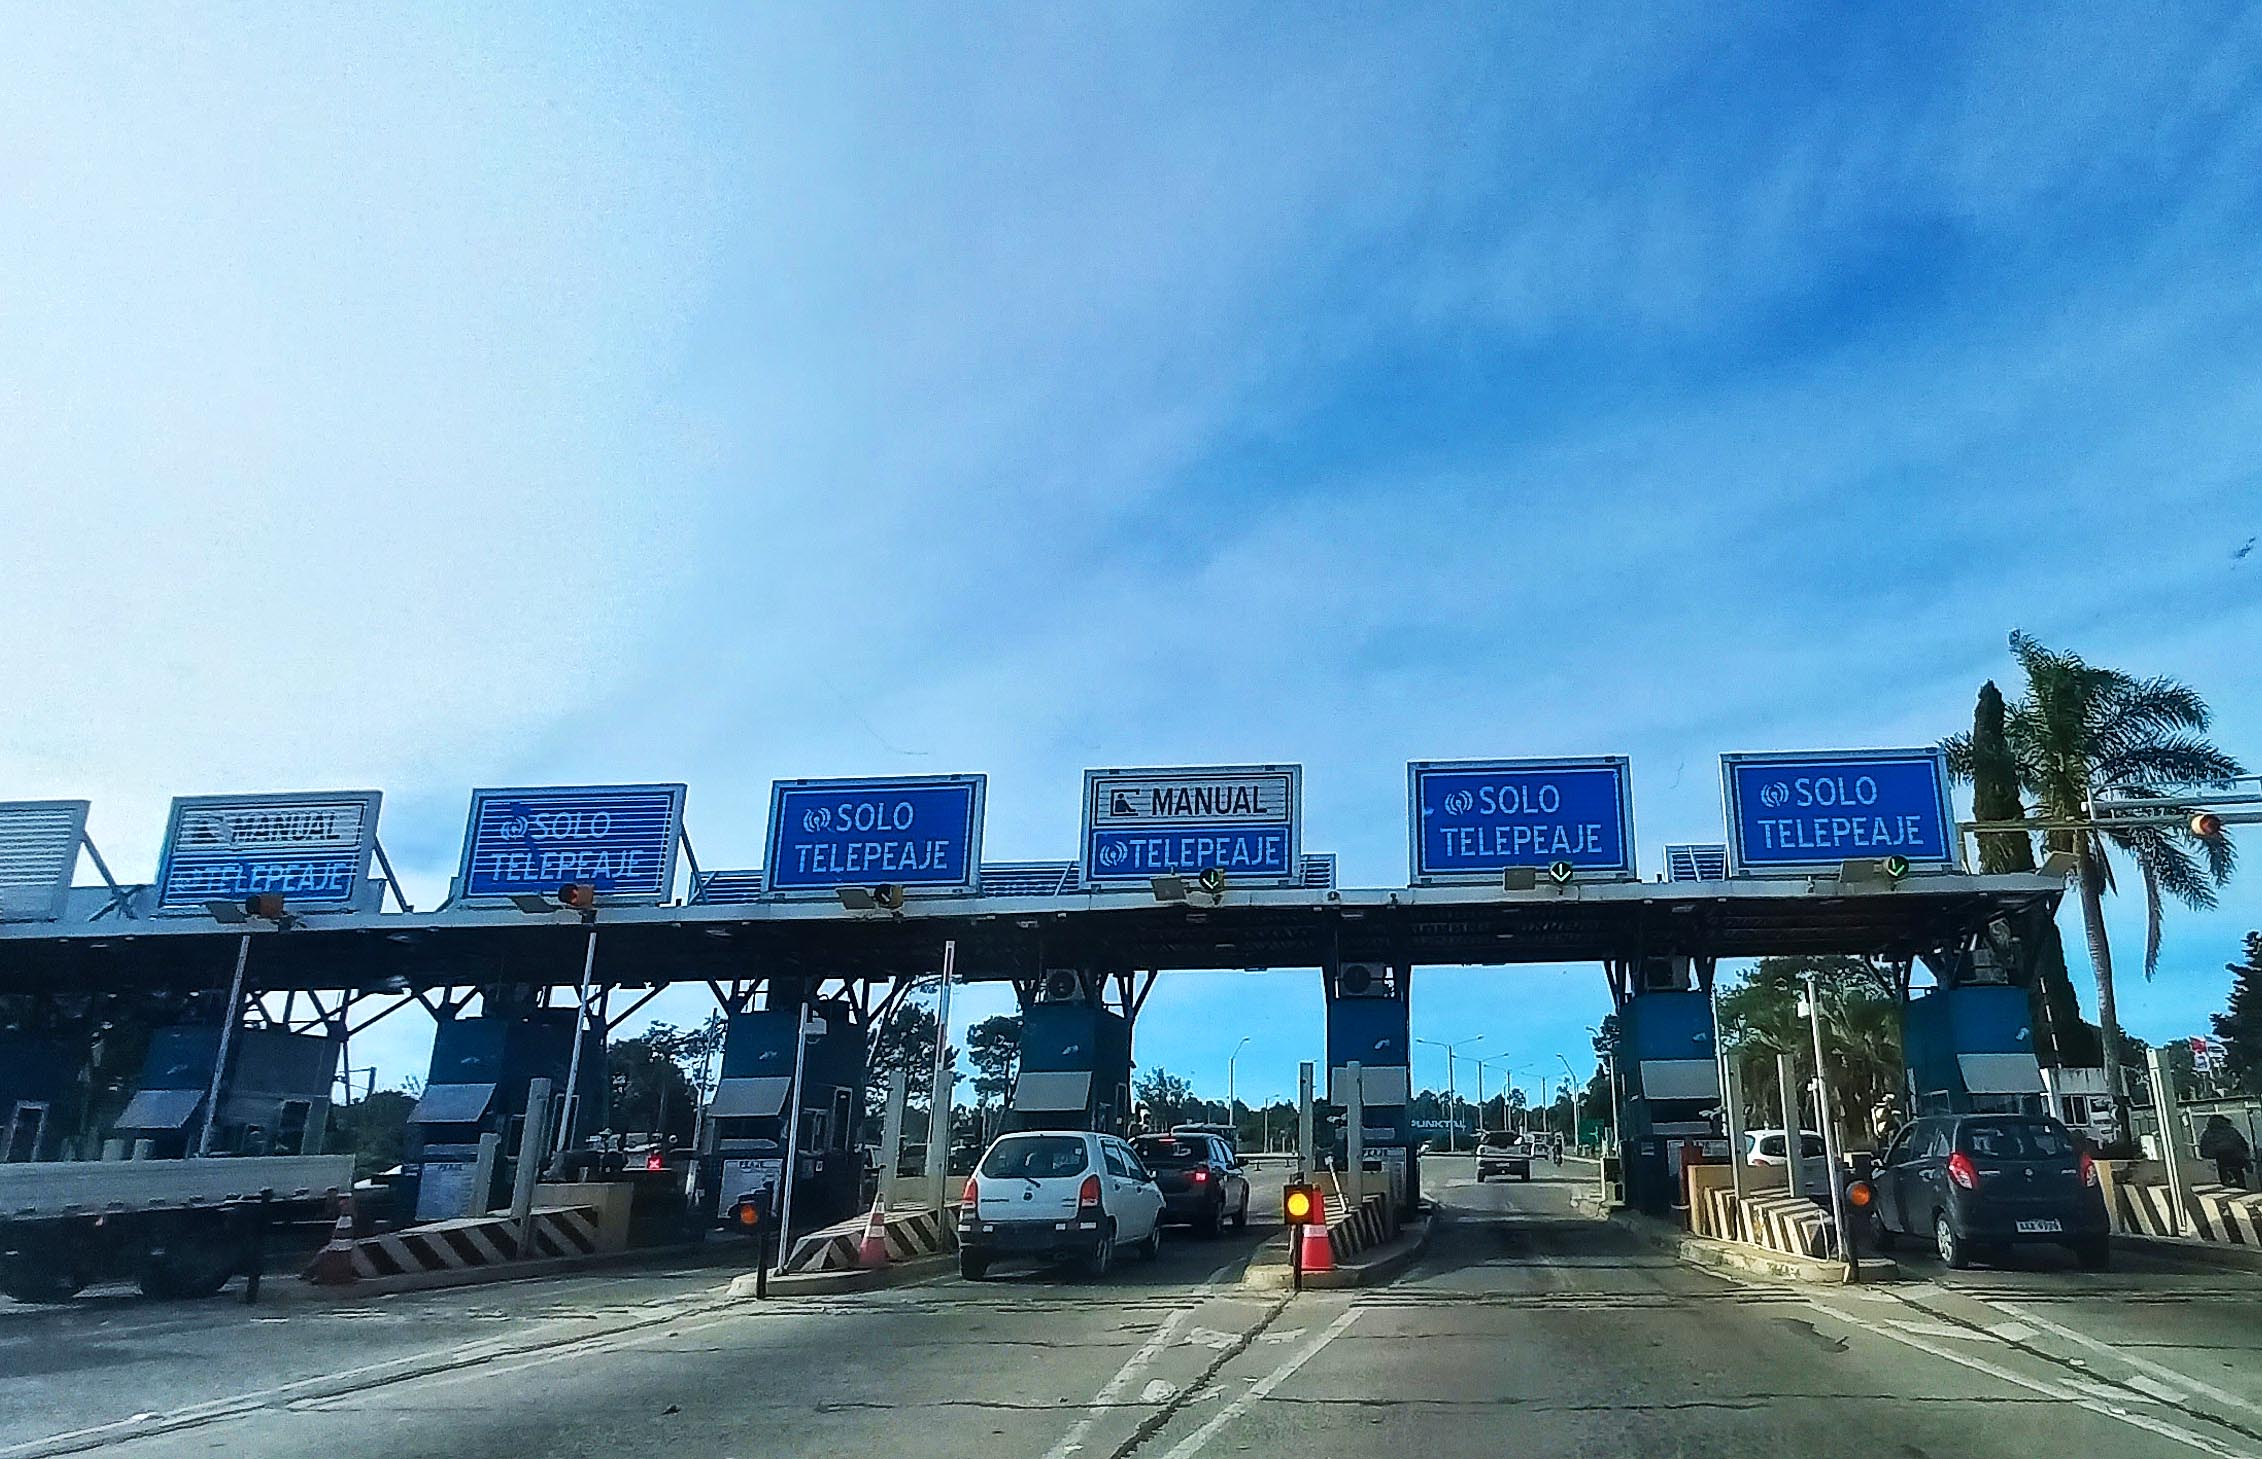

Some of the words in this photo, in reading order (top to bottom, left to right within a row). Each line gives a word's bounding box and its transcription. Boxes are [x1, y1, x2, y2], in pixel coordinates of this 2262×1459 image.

[1151, 786, 1268, 816] MANUAL
[1480, 785, 1560, 816] SOLO
[1795, 776, 1879, 808] SOLO
[234, 811, 341, 842] MANUAL
[533, 811, 612, 840] SOLO
[835, 802, 914, 833] SOLO
[1758, 815, 1924, 850] TELEPEAJE
[795, 840, 950, 873] TELEPEAJE
[1129, 836, 1281, 869] TELEPEAJE
[1440, 824, 1603, 857] TELEPEAJE
[206, 862, 353, 895] TELEPEAJE
[489, 850, 644, 883] TELEPEAJE
